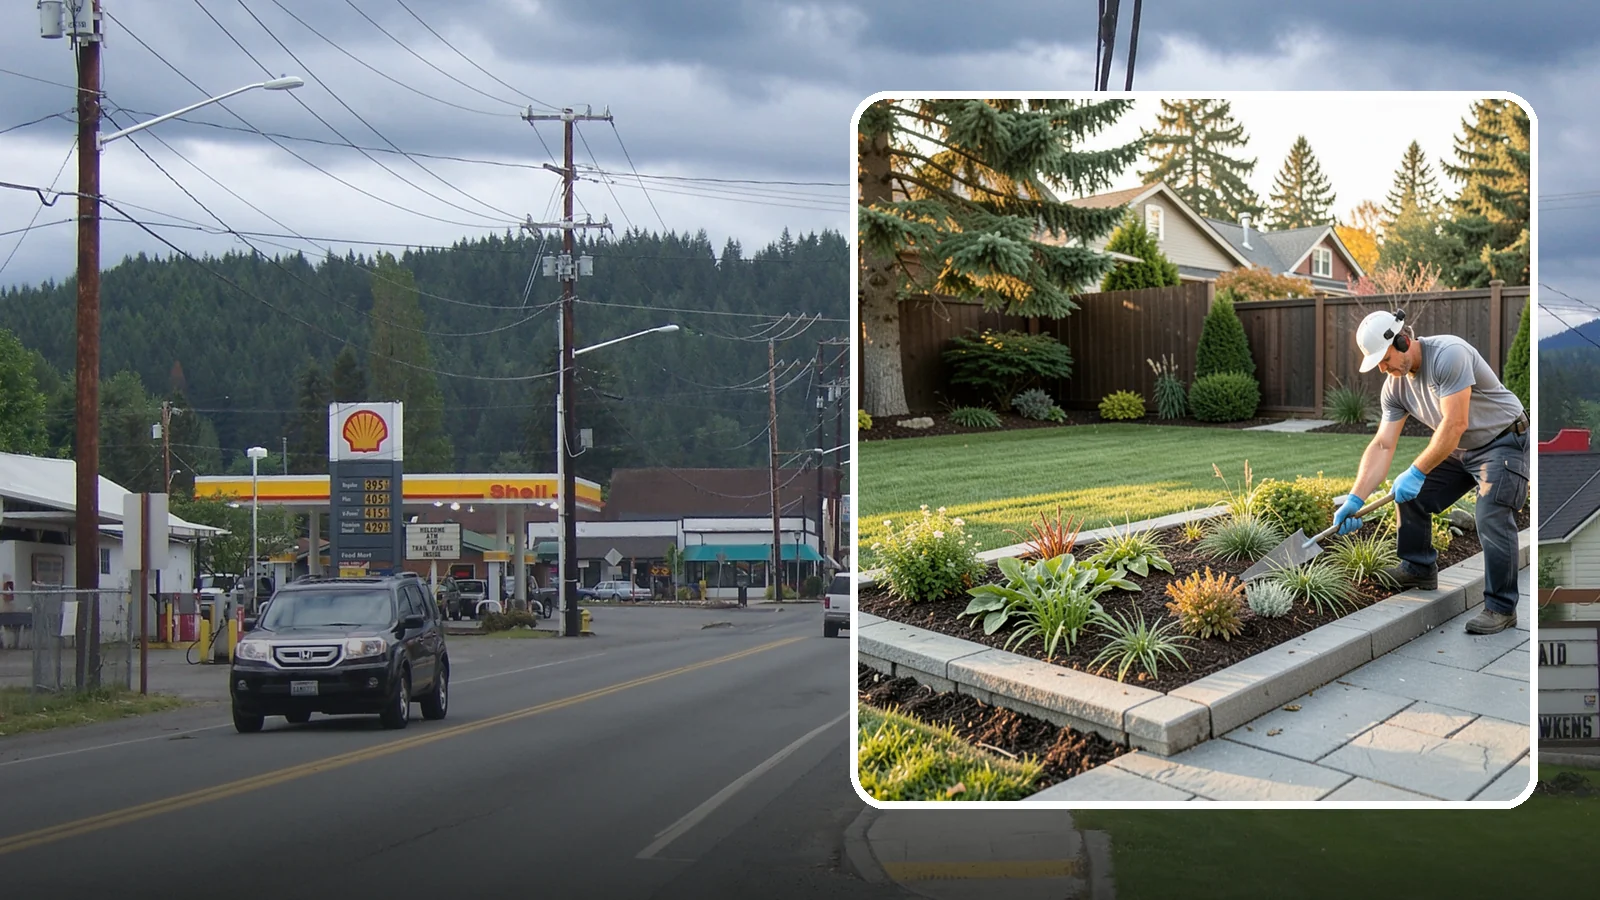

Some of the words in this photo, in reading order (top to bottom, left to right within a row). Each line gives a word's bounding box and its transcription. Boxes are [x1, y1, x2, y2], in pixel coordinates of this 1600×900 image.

[490, 484, 547, 499] Shell
[1538, 642, 1566, 665] AID
[1538, 716, 1592, 738] WKENS
